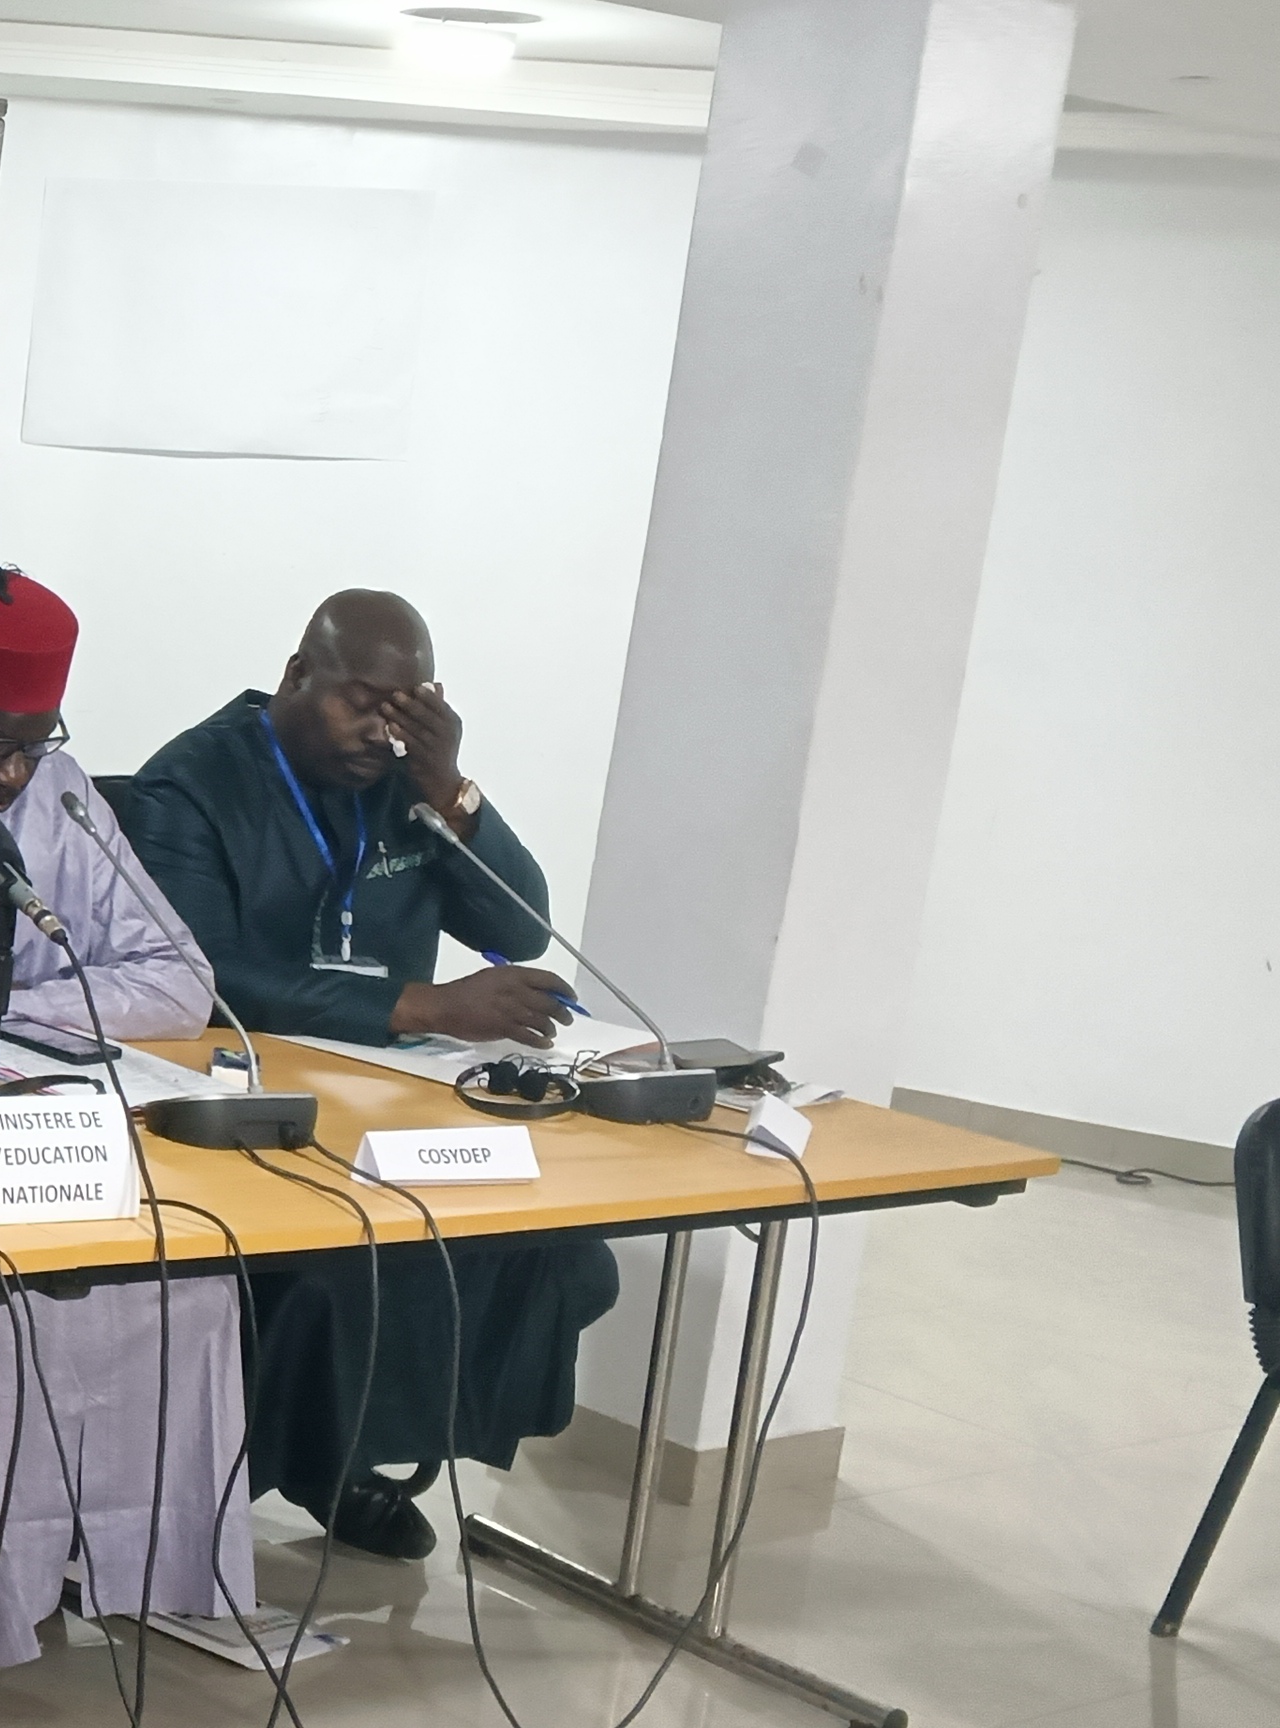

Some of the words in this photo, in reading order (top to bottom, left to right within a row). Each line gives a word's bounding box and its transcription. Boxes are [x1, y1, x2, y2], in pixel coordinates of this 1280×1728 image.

[79, 1111, 103, 1129] DE
[418, 1147, 491, 1164] COSYDEP
[2, 1183, 104, 1205] NATIONALE
